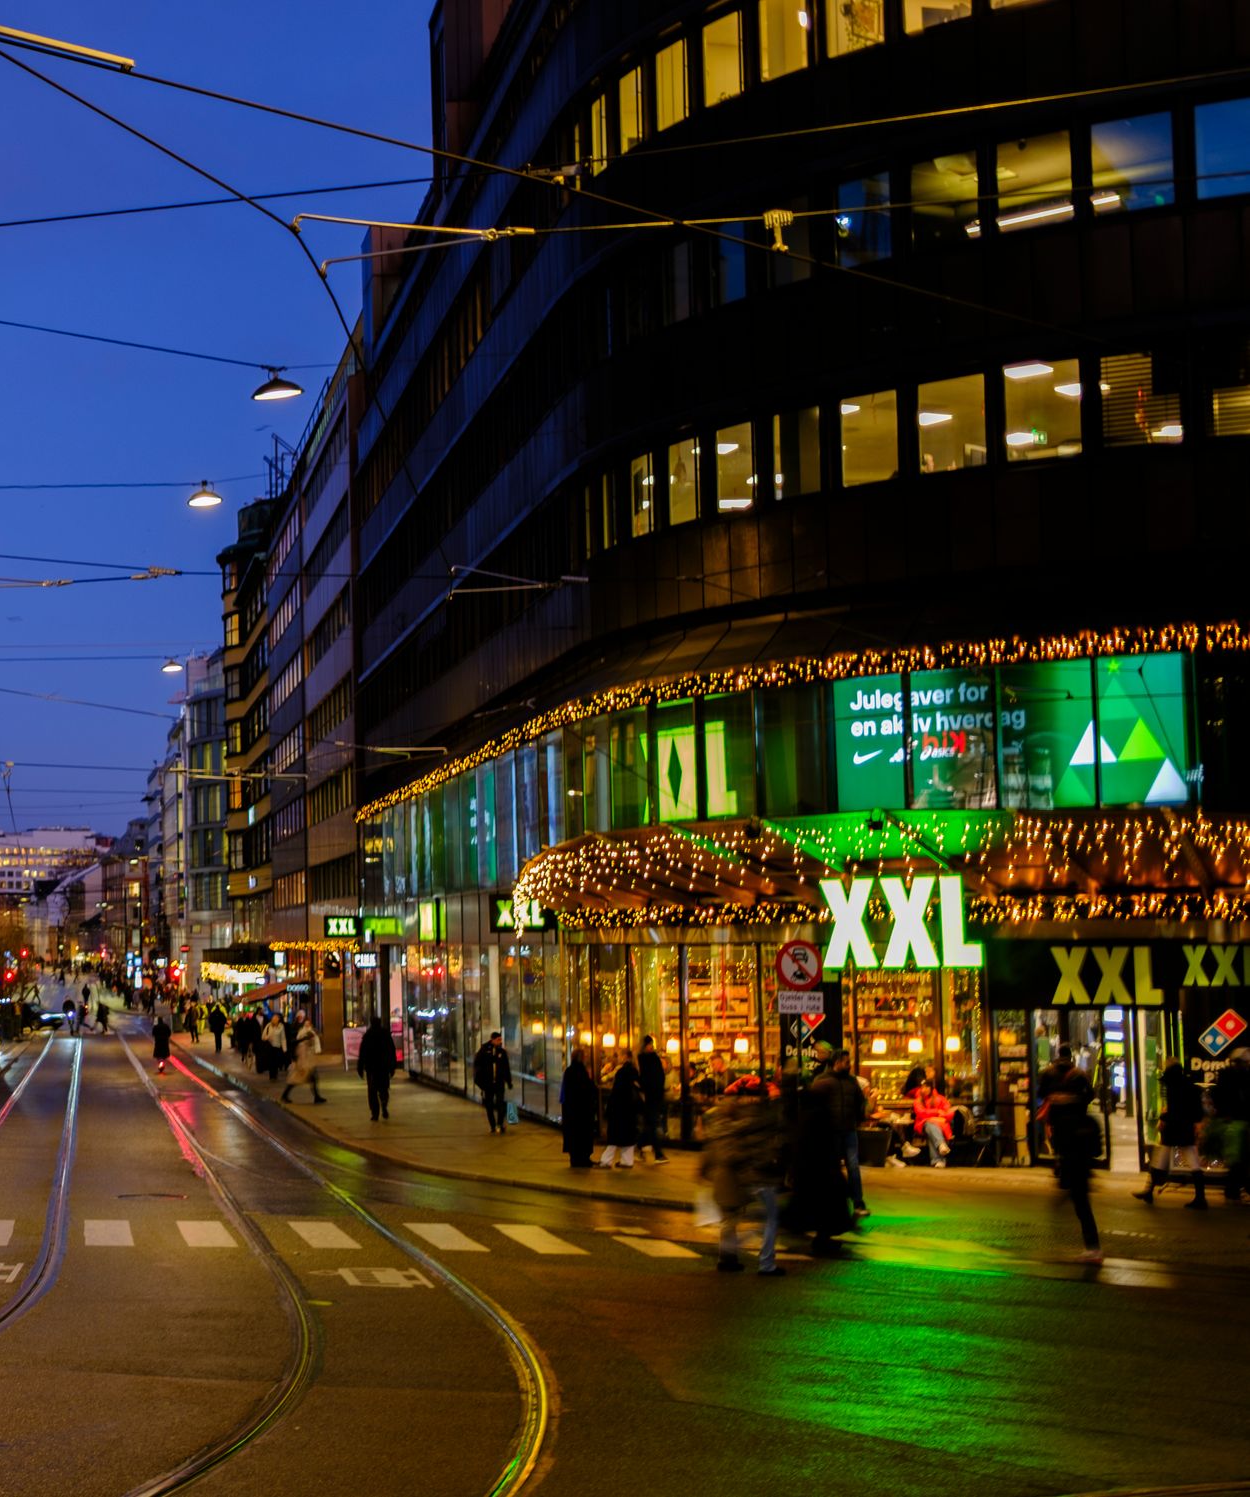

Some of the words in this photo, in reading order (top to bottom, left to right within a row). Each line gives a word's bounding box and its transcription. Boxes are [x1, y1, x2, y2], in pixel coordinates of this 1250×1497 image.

[850, 688, 954, 712] Julegaver
[958, 682, 988, 703] for
[850, 721, 877, 737] en
[881, 713, 931, 736] akiv
[327, 918, 356, 935] XXL
[819, 875, 984, 969] XXL
[1051, 946, 1164, 1005] XXL
